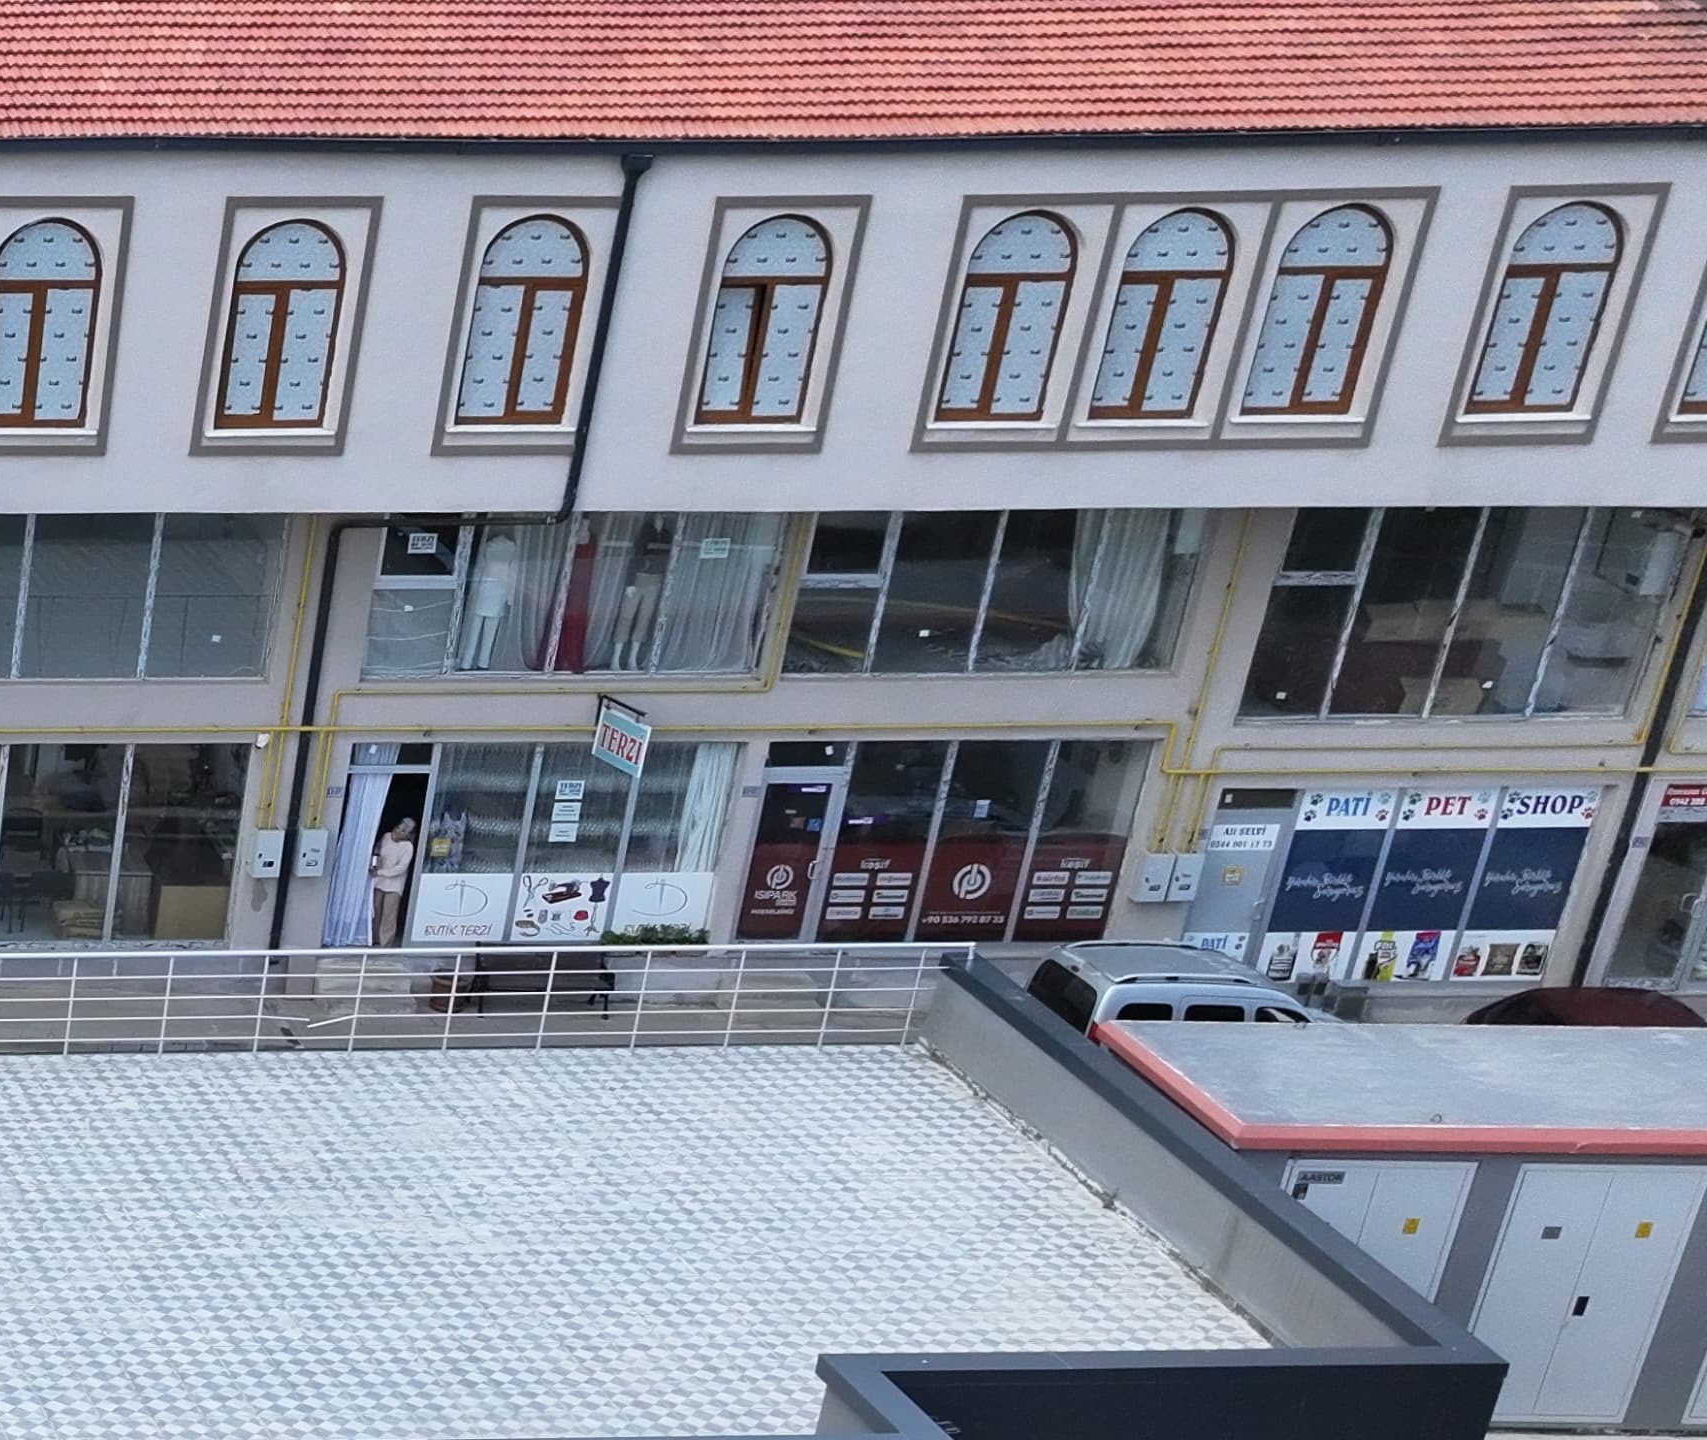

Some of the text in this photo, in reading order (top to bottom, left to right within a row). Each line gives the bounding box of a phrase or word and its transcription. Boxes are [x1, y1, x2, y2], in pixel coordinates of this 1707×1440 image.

[1326, 791, 1372, 817] PATİ
[1424, 796, 1472, 816] PET
[1516, 795, 1583, 815] SHOP
